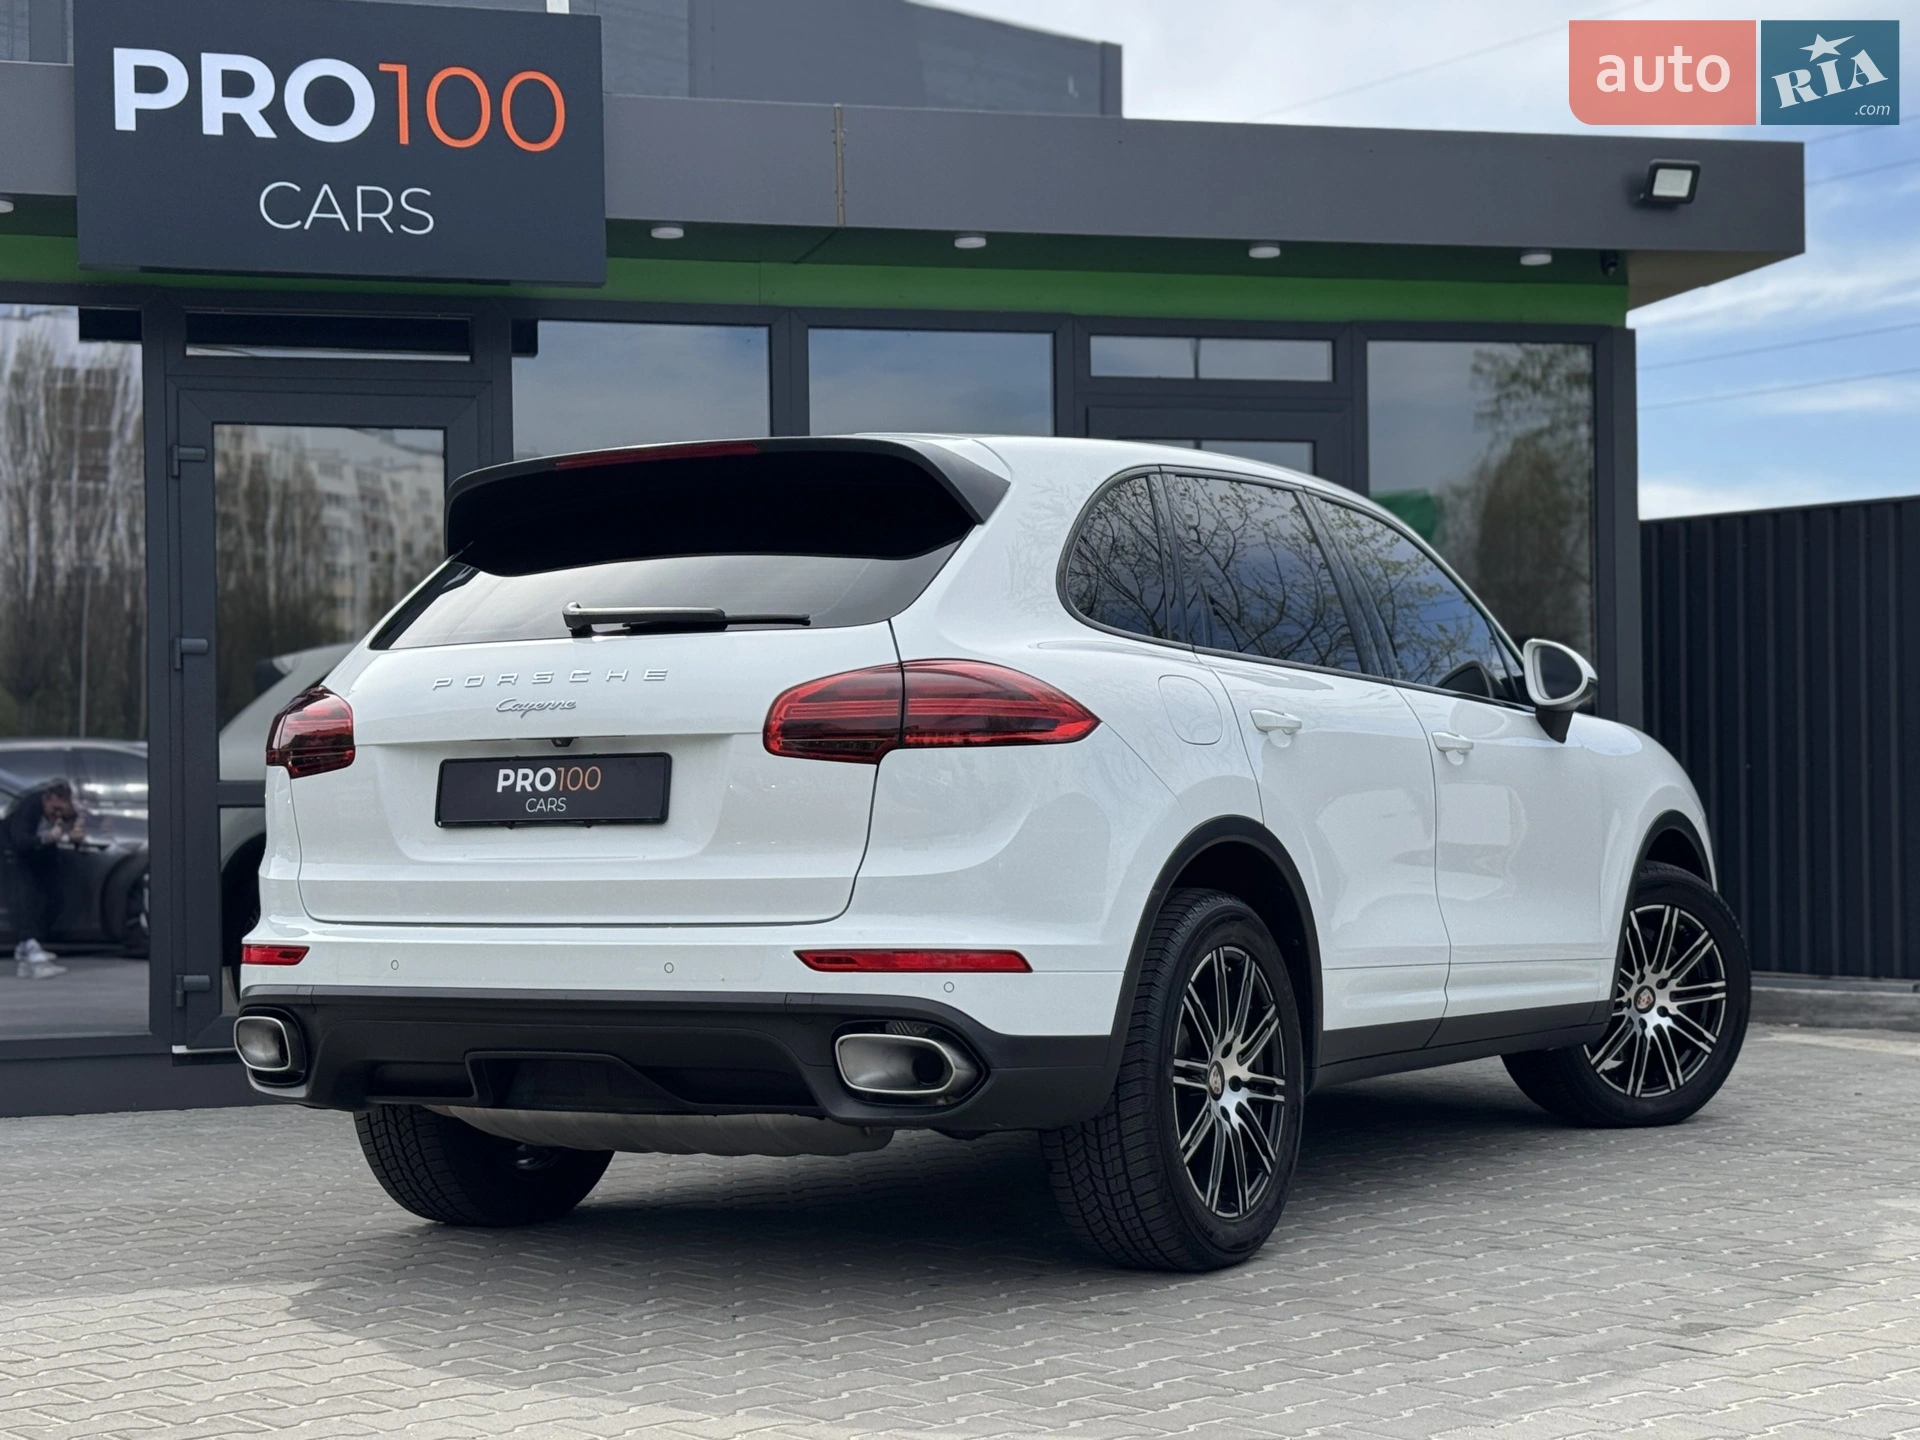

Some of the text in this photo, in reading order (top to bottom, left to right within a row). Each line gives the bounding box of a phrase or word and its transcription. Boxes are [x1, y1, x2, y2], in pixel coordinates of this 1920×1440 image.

[113, 47, 565, 152] PRO100
[260, 181, 434, 234] CARS
[432, 669, 668, 690] PORSCHE
[496, 698, 576, 718] Cayenne
[496, 766, 602, 793] PRO100
[525, 797, 567, 813] CARS
